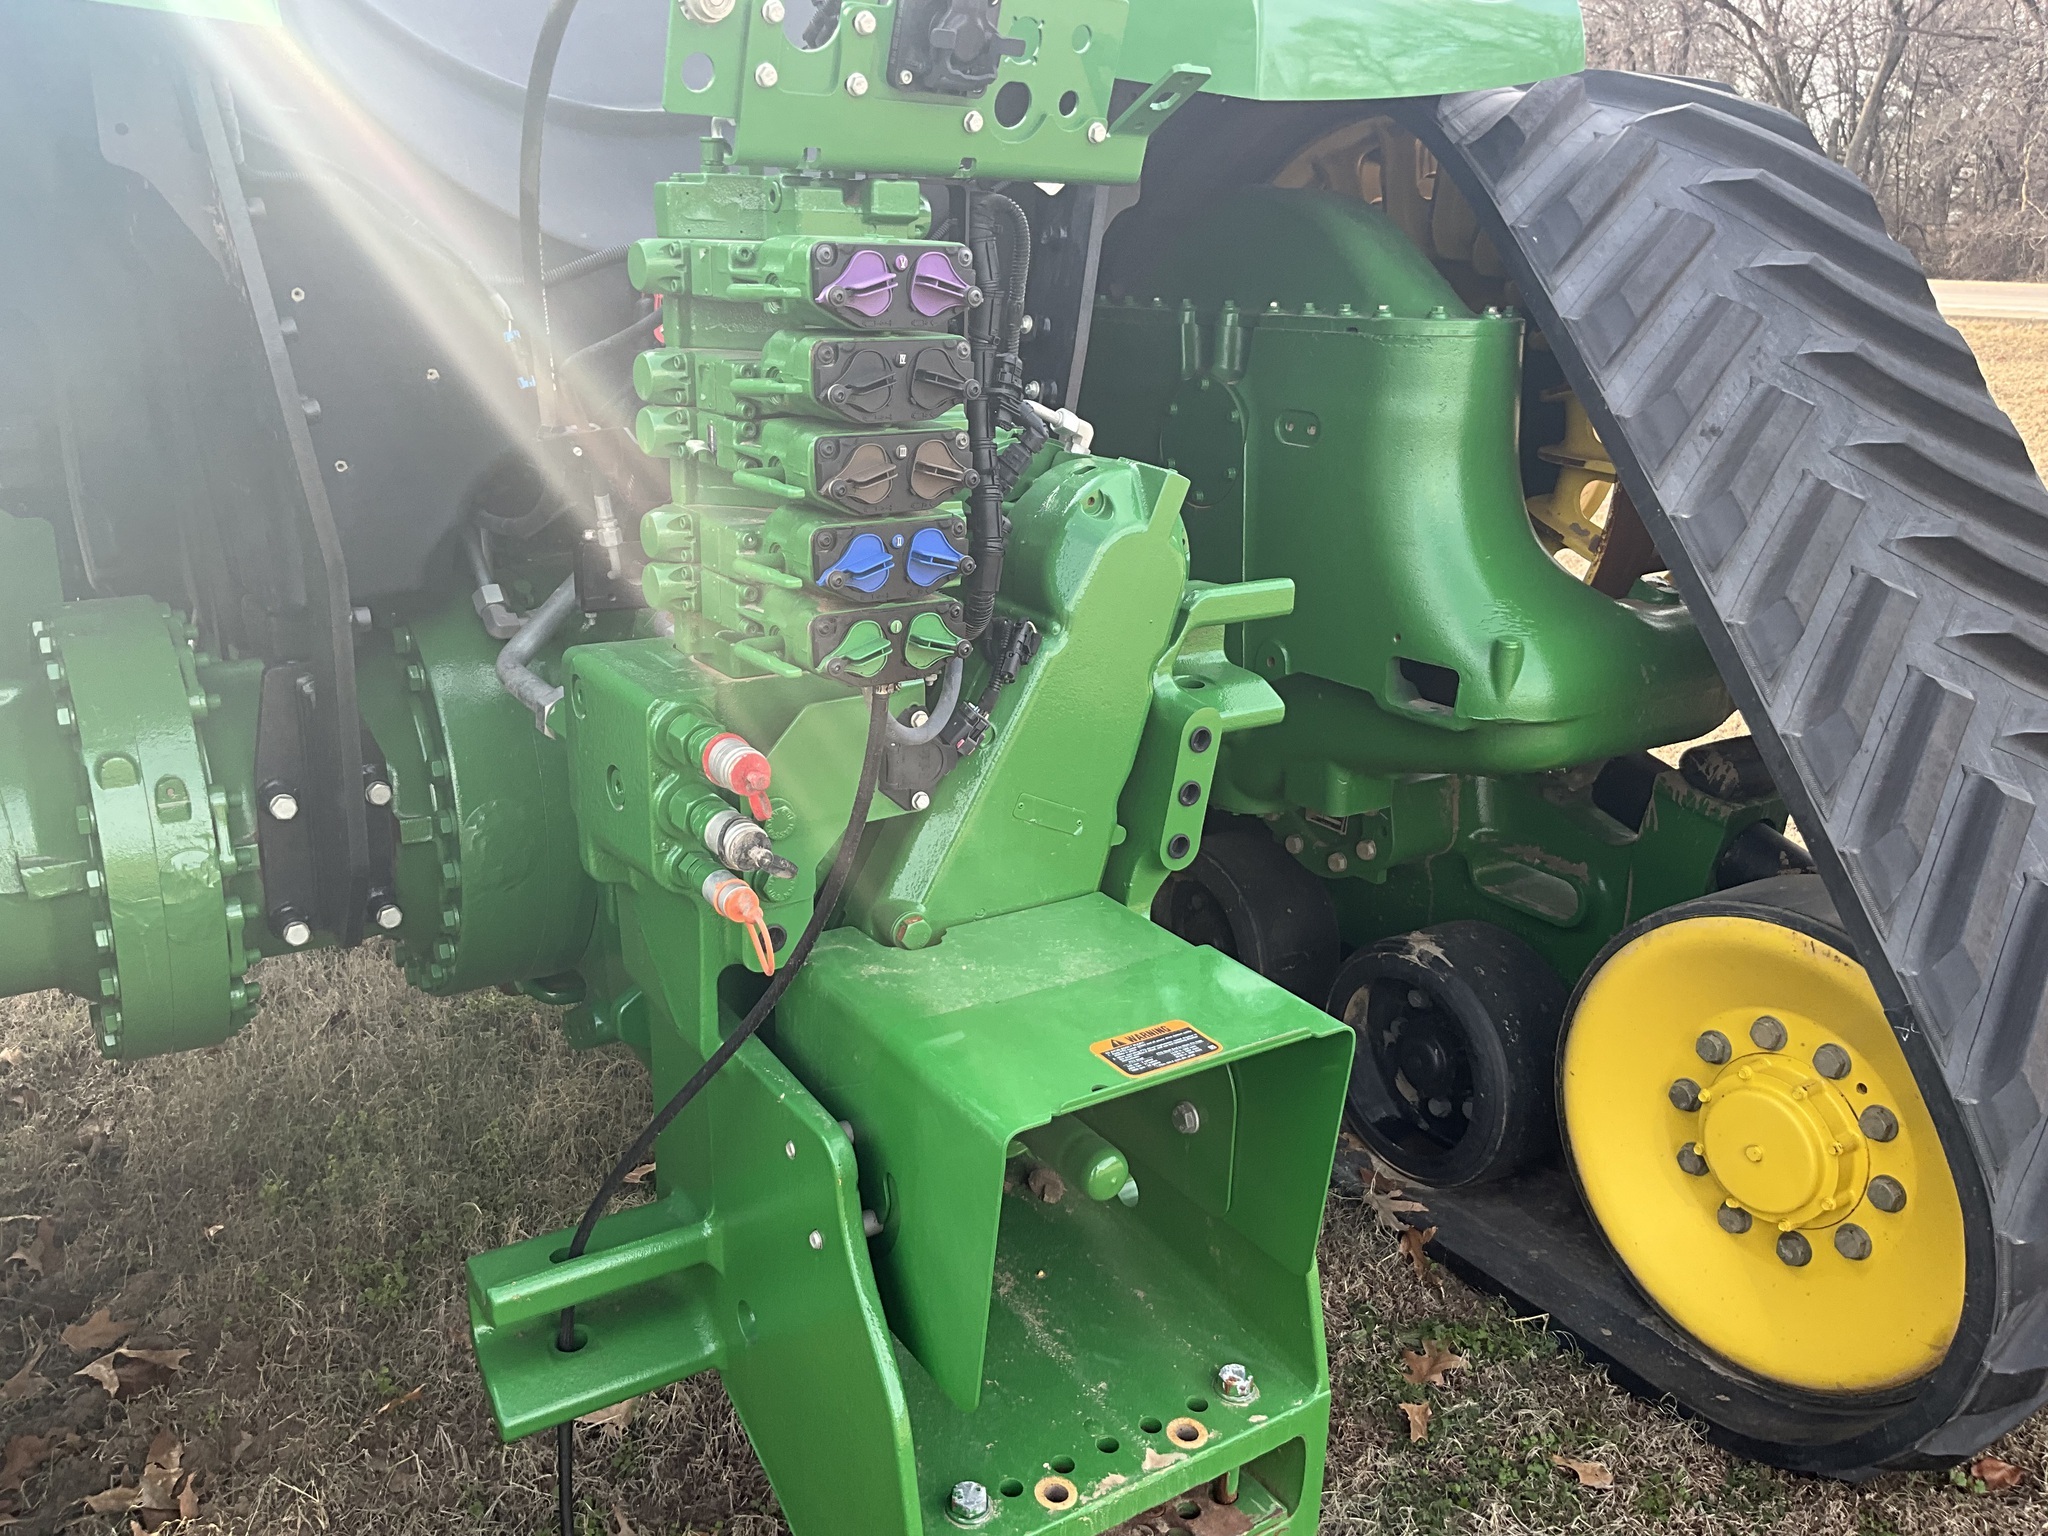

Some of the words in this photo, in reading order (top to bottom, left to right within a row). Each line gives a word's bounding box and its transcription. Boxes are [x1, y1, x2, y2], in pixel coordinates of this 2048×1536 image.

[899, 257, 907, 269] V
[899, 354, 907, 365] IV
[899, 447, 907, 457] III
[896, 537, 902, 547] II
[1125, 1026, 1172, 1042] WARNING
